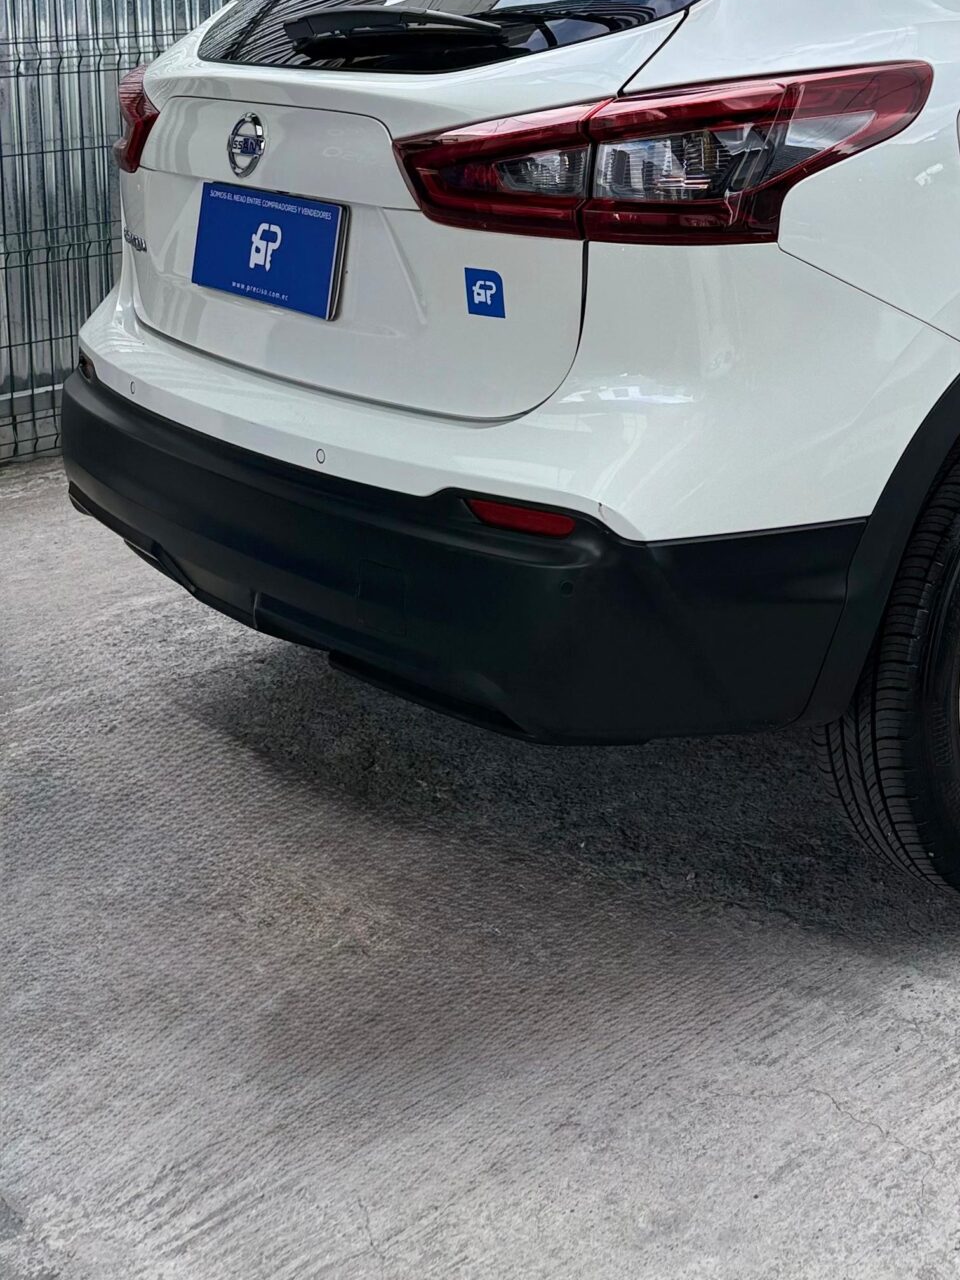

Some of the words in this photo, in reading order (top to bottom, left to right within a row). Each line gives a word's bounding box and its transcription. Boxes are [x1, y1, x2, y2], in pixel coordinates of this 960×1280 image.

[210, 190, 227, 199] SOMOS
[233, 195, 246, 203] NEXO
[247, 197, 261, 206] ENTRE
[262, 200, 297, 213] COMPRADORES
[302, 207, 331, 220] VENDEDORES
[232, 281, 288, 301] www.preciso.com.ec
